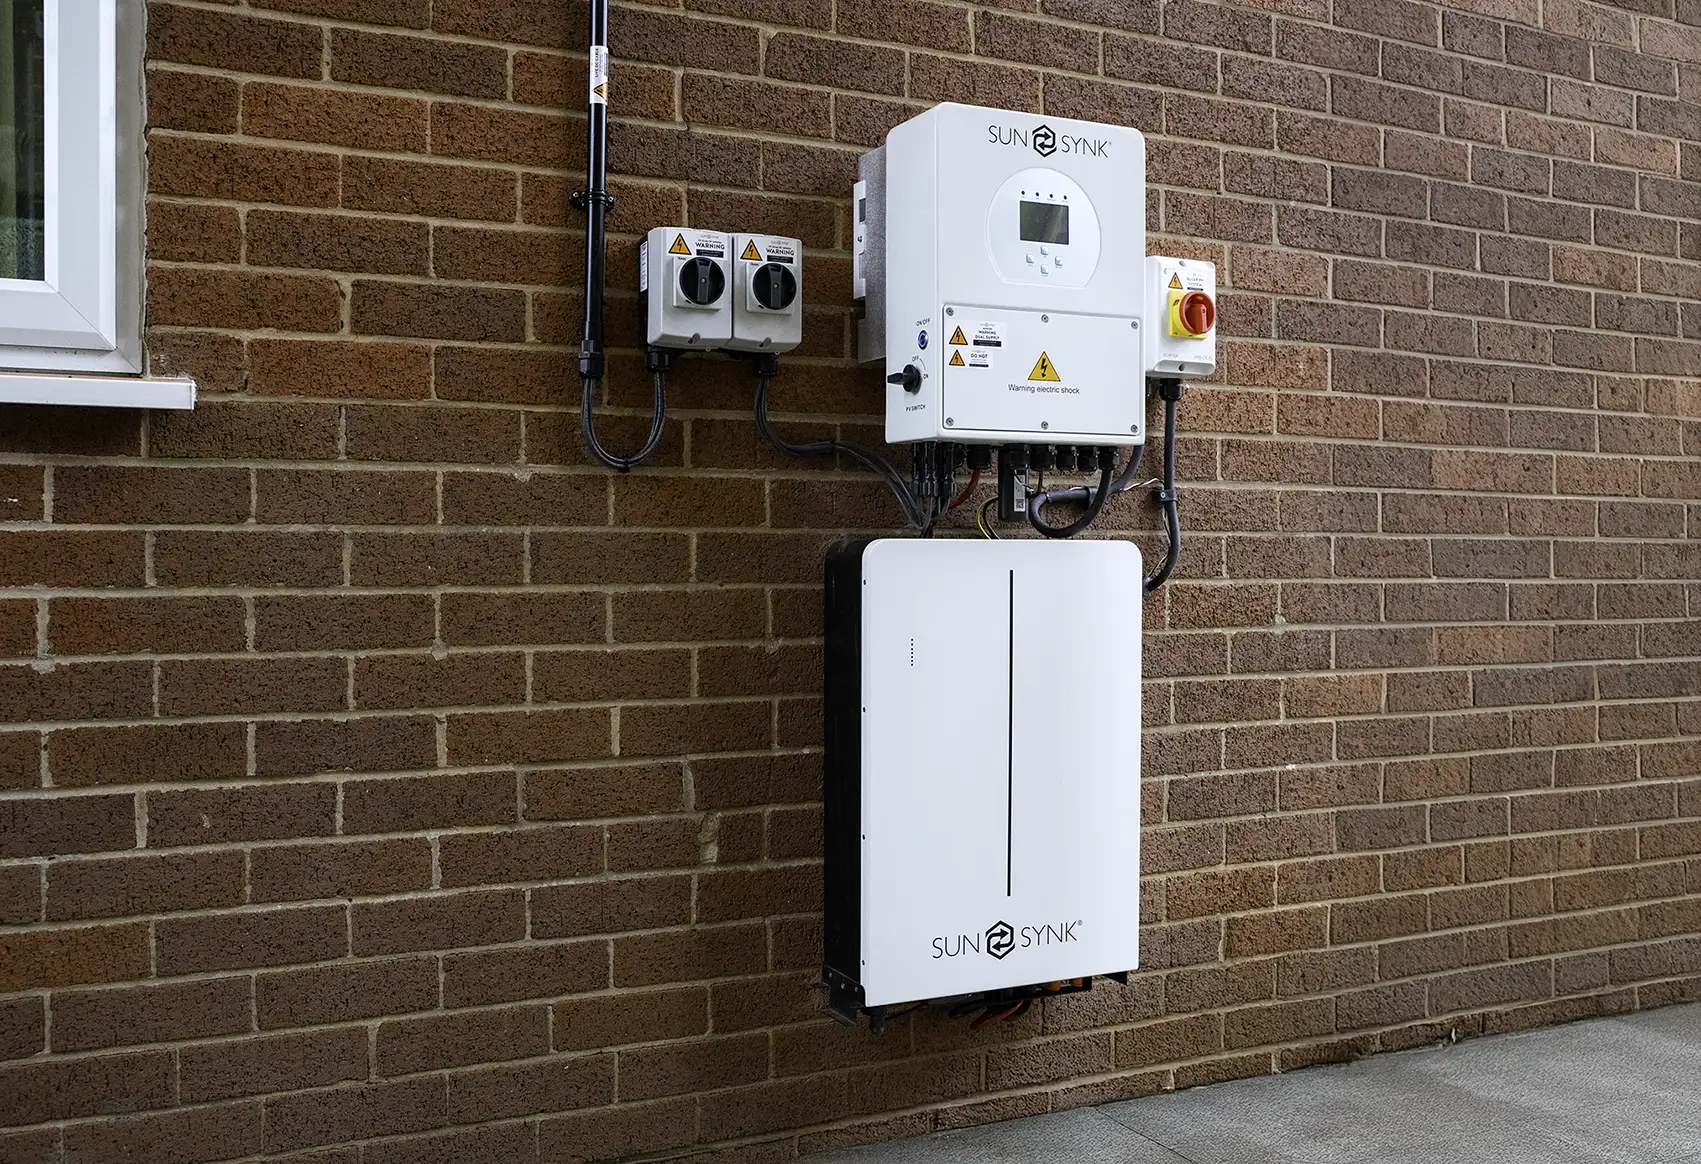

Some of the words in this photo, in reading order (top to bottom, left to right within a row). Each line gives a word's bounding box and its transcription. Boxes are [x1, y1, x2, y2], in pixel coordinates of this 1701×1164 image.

[988, 124, 1028, 147] SUN
[694, 242, 725, 250] WARNING
[766, 248, 794, 256] WARNING
[916, 318, 931, 326] ON/OFF
[1008, 384, 1035, 393] Warning
[932, 932, 979, 959] SUN
